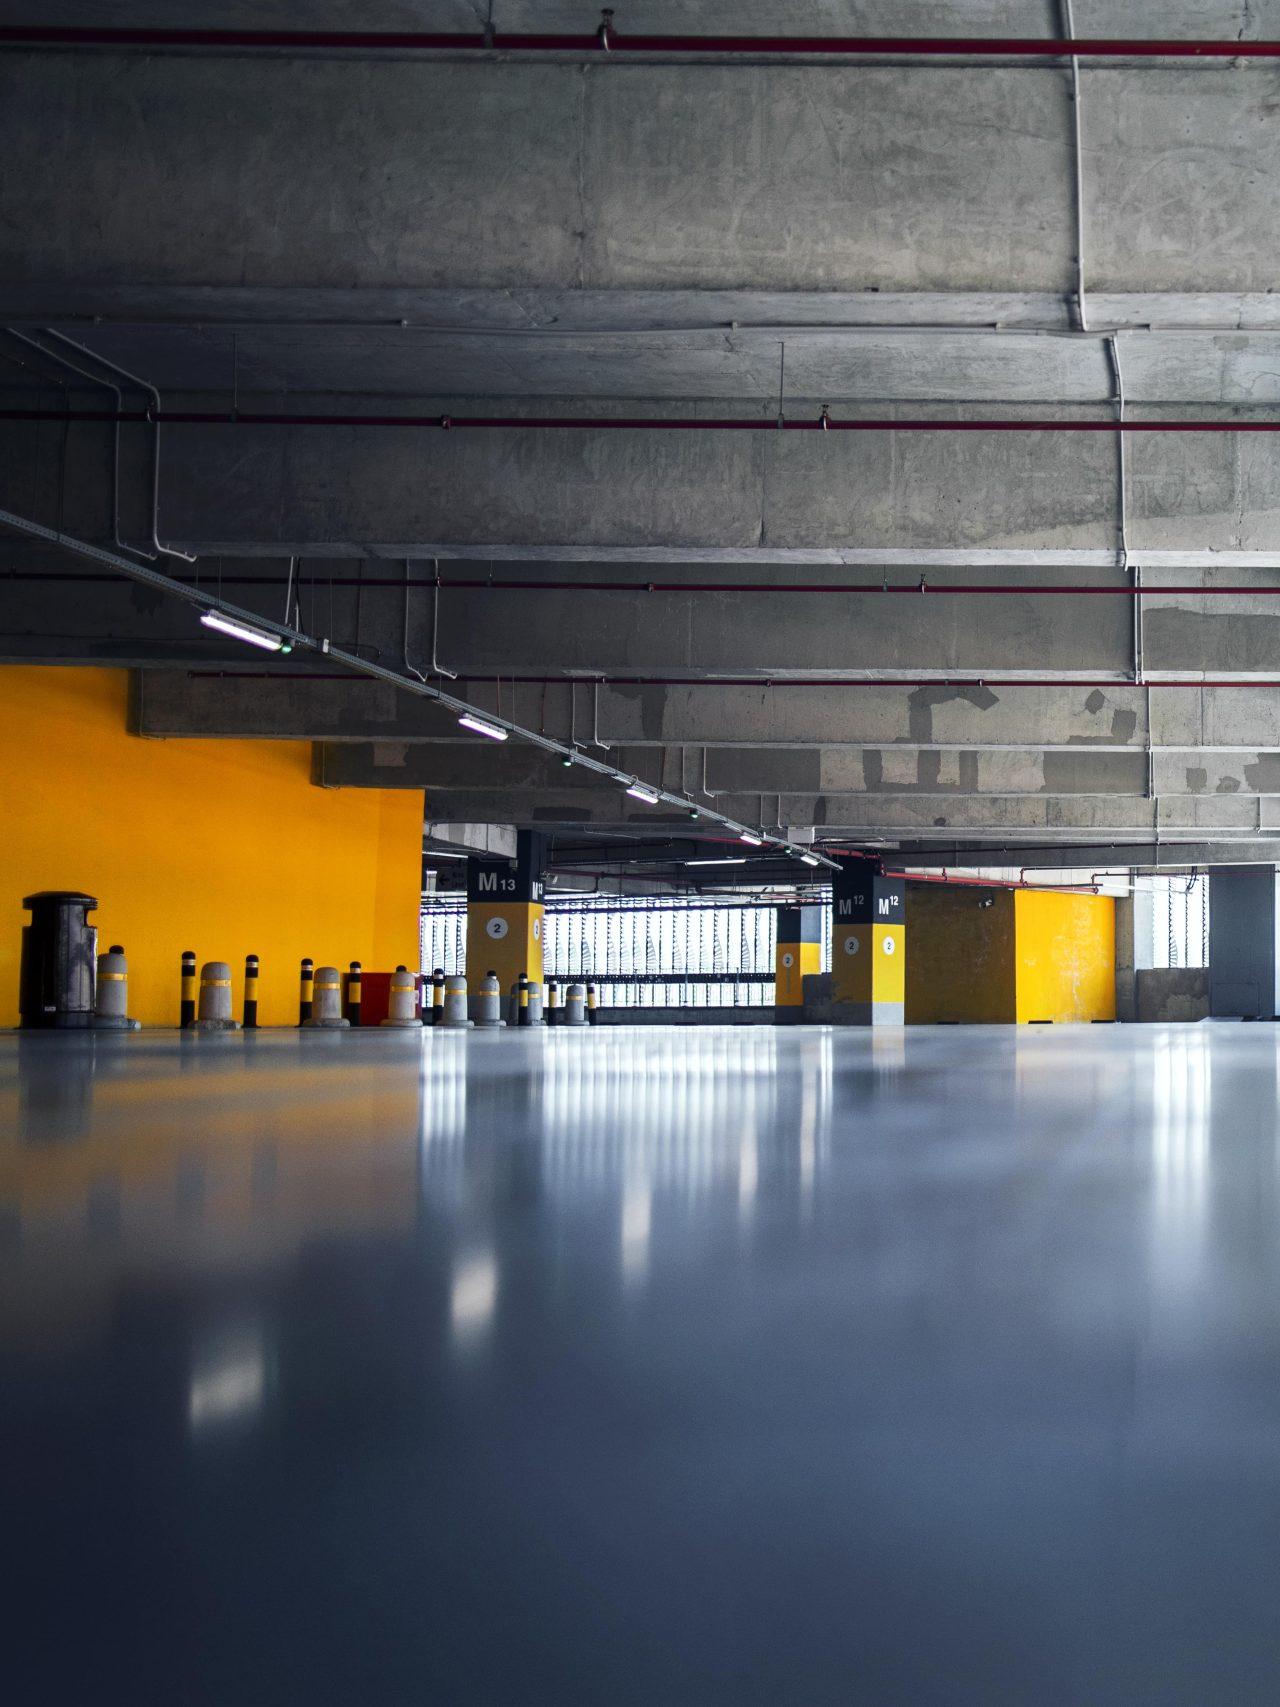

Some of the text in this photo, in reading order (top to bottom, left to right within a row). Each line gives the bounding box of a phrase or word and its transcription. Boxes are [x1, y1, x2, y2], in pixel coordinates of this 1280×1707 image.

[479, 873, 497, 891] M
[500, 879, 516, 891] 13
[839, 895, 865, 915] M 12
[878, 896, 899, 915] M 12
[494, 924, 501, 933] 2
[887, 942, 892, 950] 2
